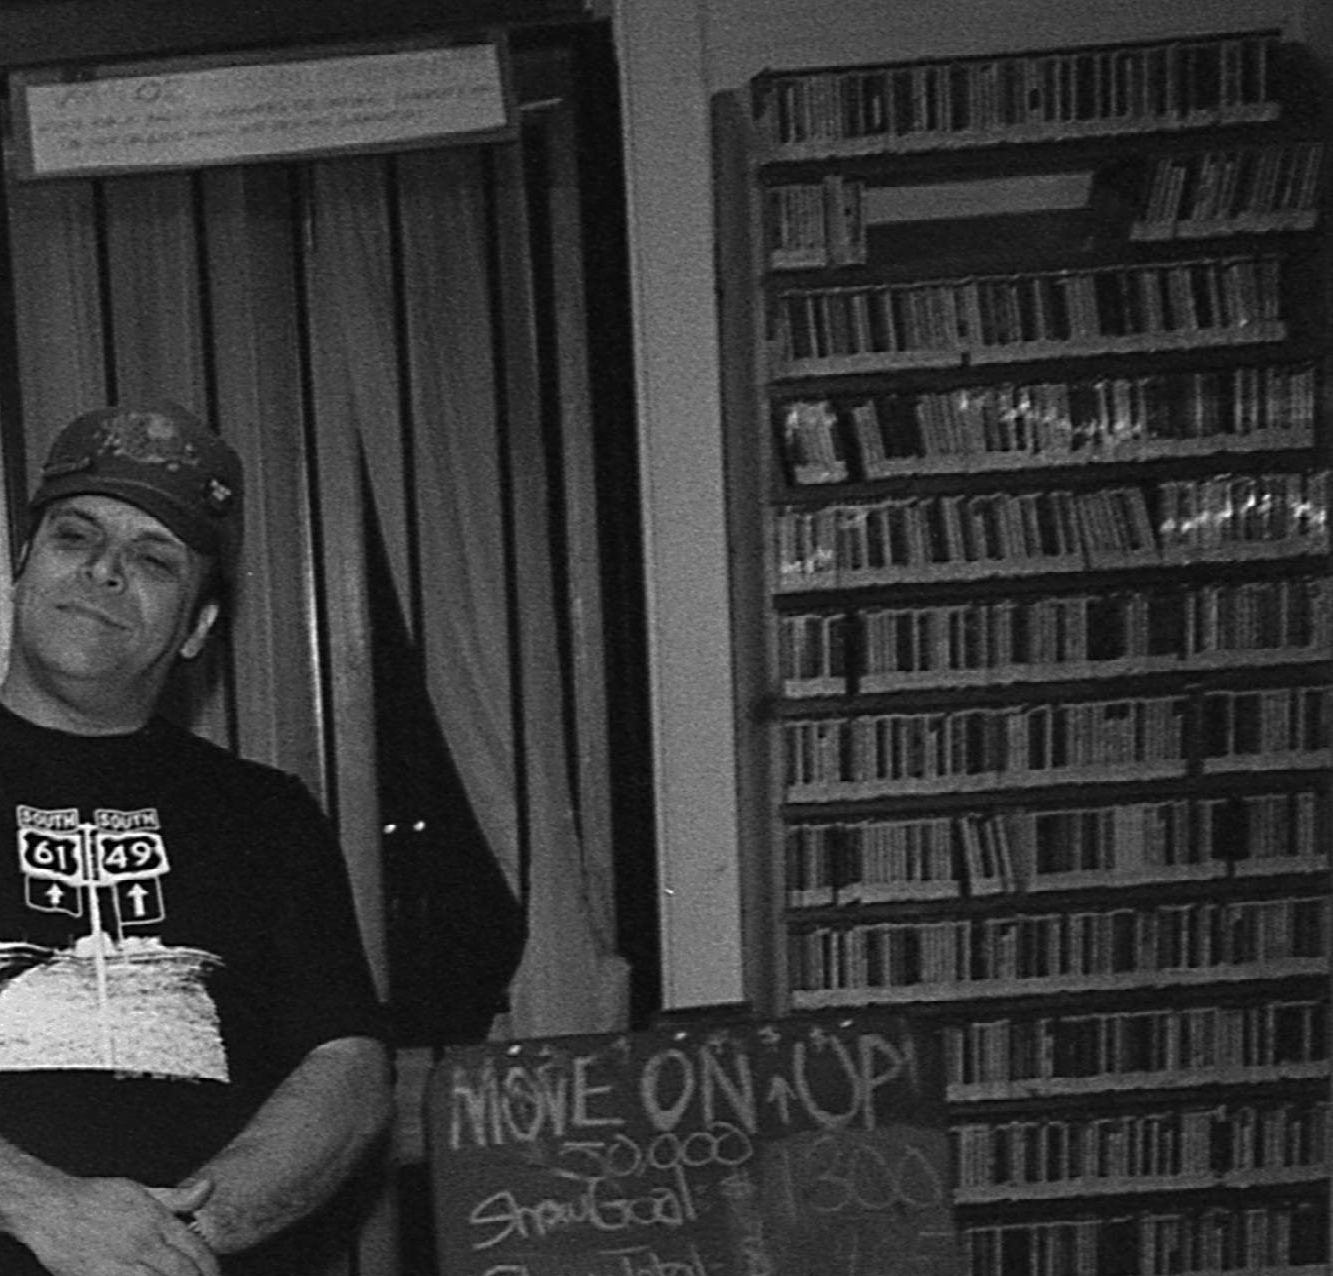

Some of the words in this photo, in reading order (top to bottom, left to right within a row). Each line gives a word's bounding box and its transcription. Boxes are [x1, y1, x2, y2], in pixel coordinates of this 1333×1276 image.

[21, 808, 76, 829] SOUTH
[98, 812, 157, 831] SOUTH
[34, 839, 67, 871] 61
[104, 840, 153, 870] 49
[448, 1054, 626, 1150] MOVE
[641, 1043, 758, 1135] ON
